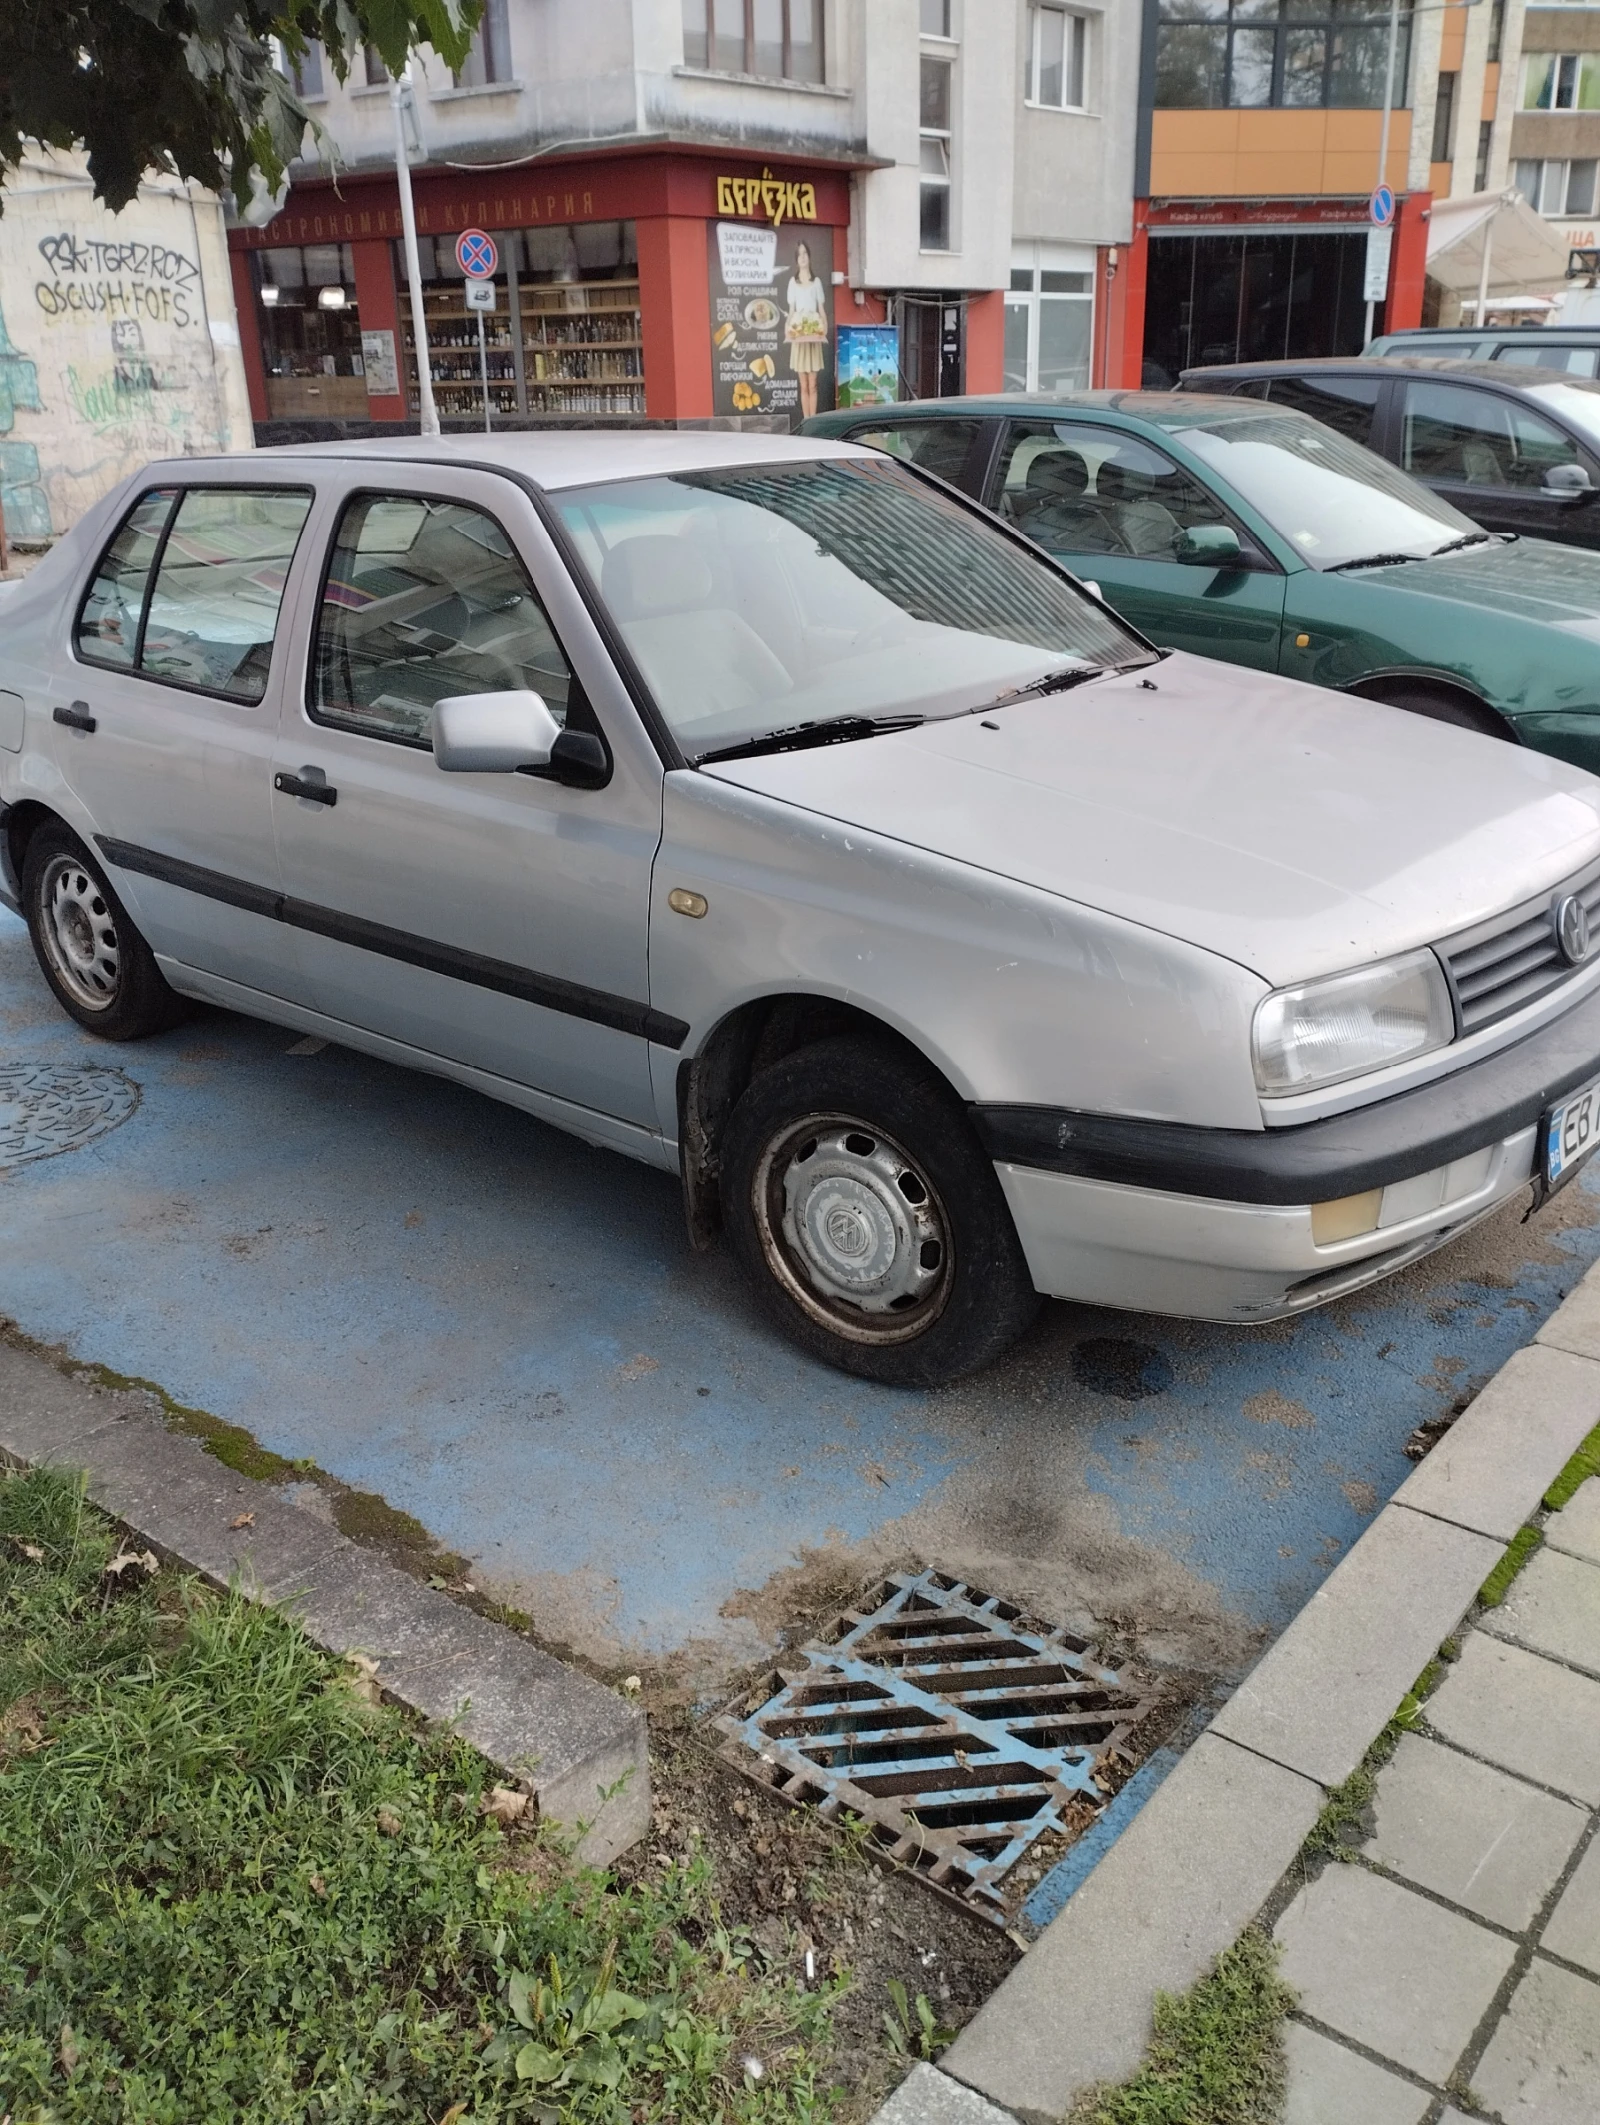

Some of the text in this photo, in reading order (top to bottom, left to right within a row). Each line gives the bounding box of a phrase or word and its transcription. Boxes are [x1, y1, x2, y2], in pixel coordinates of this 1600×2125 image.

[419, 206, 429, 228] И
[445, 192, 593, 226] КУЛИНАРИЯ
[1350, 210, 1370, 221] клу
[725, 270, 768, 279] КУЛИНАРИЯ
[1550, 1148, 1560, 1168] BG
